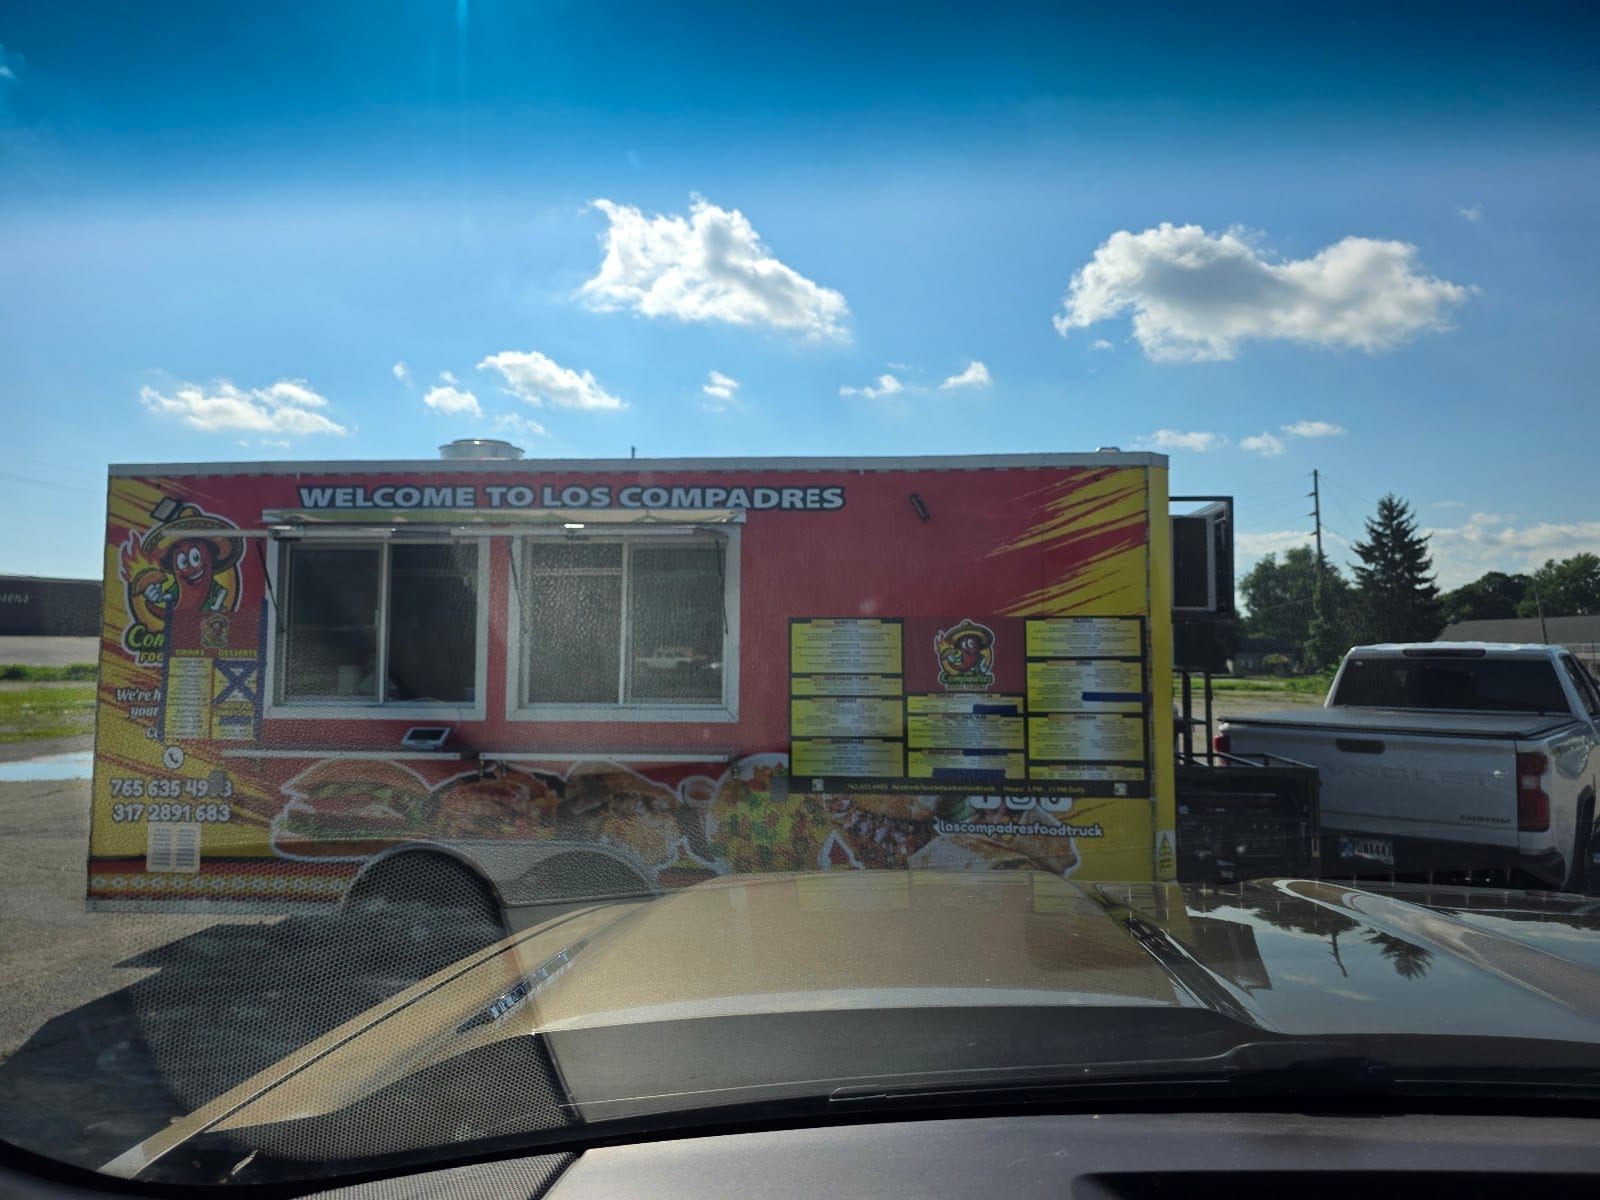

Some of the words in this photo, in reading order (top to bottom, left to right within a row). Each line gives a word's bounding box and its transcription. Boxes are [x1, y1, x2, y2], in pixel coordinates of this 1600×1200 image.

[299, 486, 475, 508] WELCOME
[486, 487, 535, 508] TO
[541, 487, 611, 508] LOS
[619, 486, 845, 510] COMPADRES
[111, 779, 144, 797] 765
[148, 779, 182, 797] 635
[185, 779, 233, 797] 493
[113, 803, 145, 822] 317
[148, 804, 192, 822] 2891
[195, 804, 231, 822] 683
